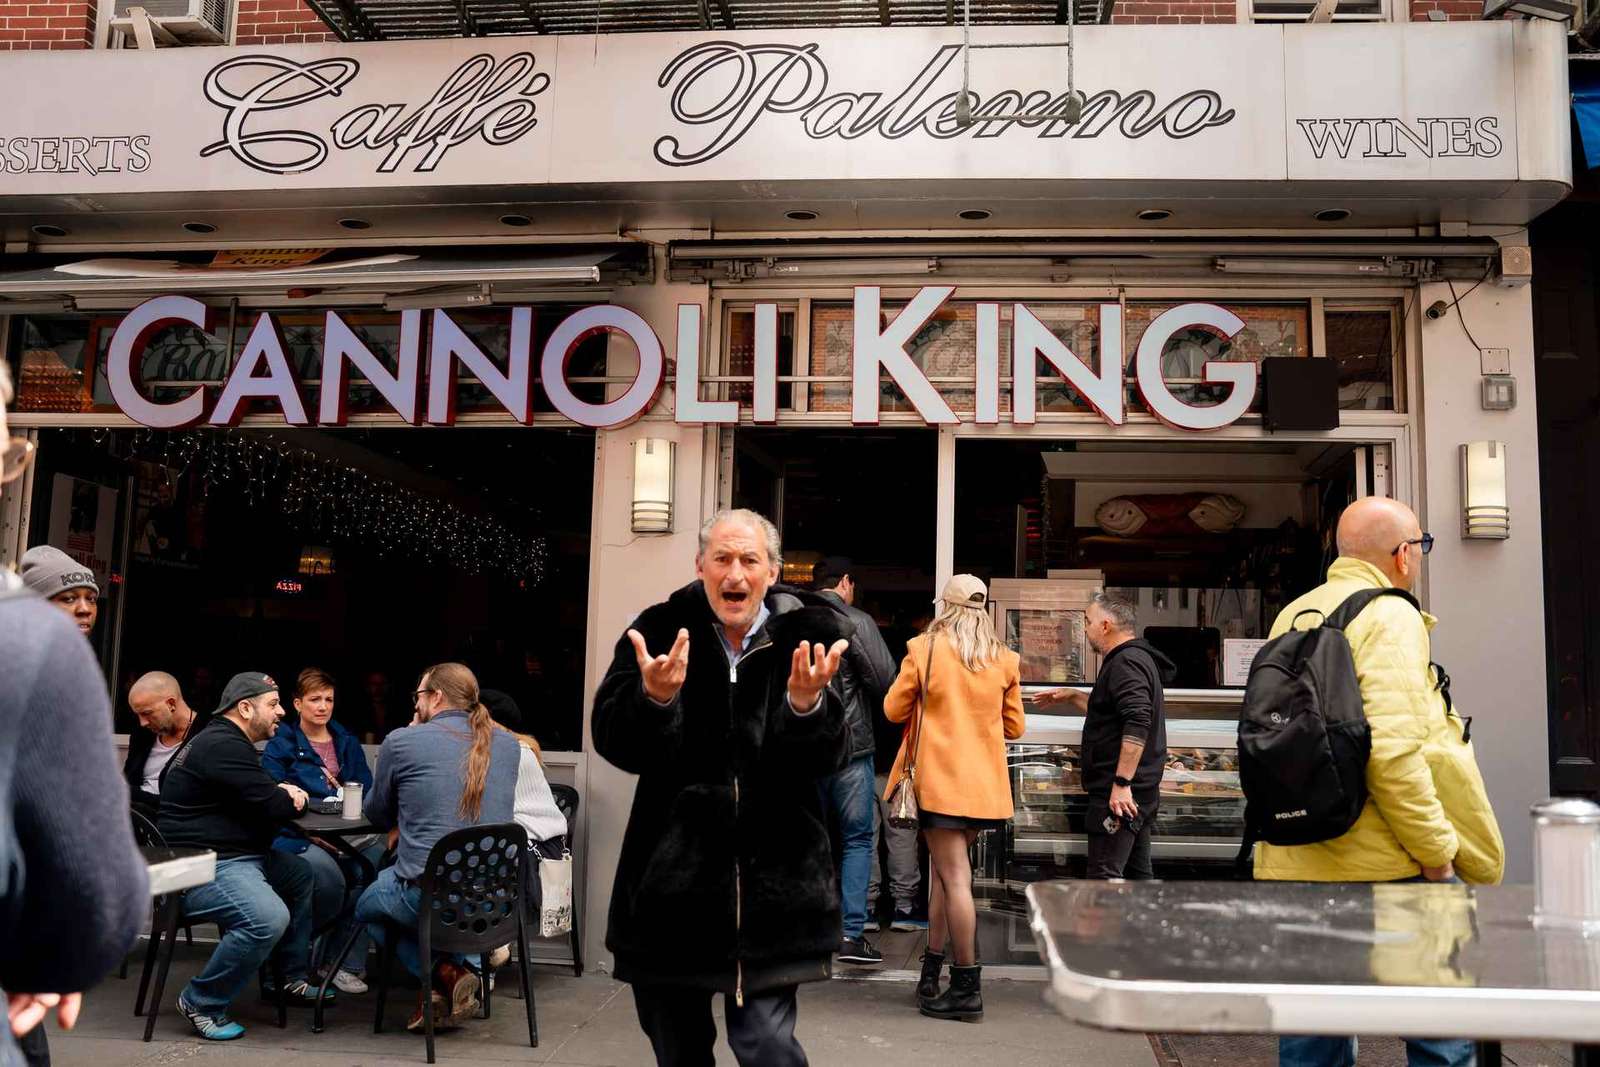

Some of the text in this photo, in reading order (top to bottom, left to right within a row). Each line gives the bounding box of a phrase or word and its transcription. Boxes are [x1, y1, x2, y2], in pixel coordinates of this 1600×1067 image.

[200, 40, 1236, 175] Caffé Palermo
[0, 134, 152, 177] SERTS
[1296, 116, 1503, 159] WINES
[107, 285, 1257, 431] CANNOLI KING
[1275, 809, 1307, 820] POLICE
